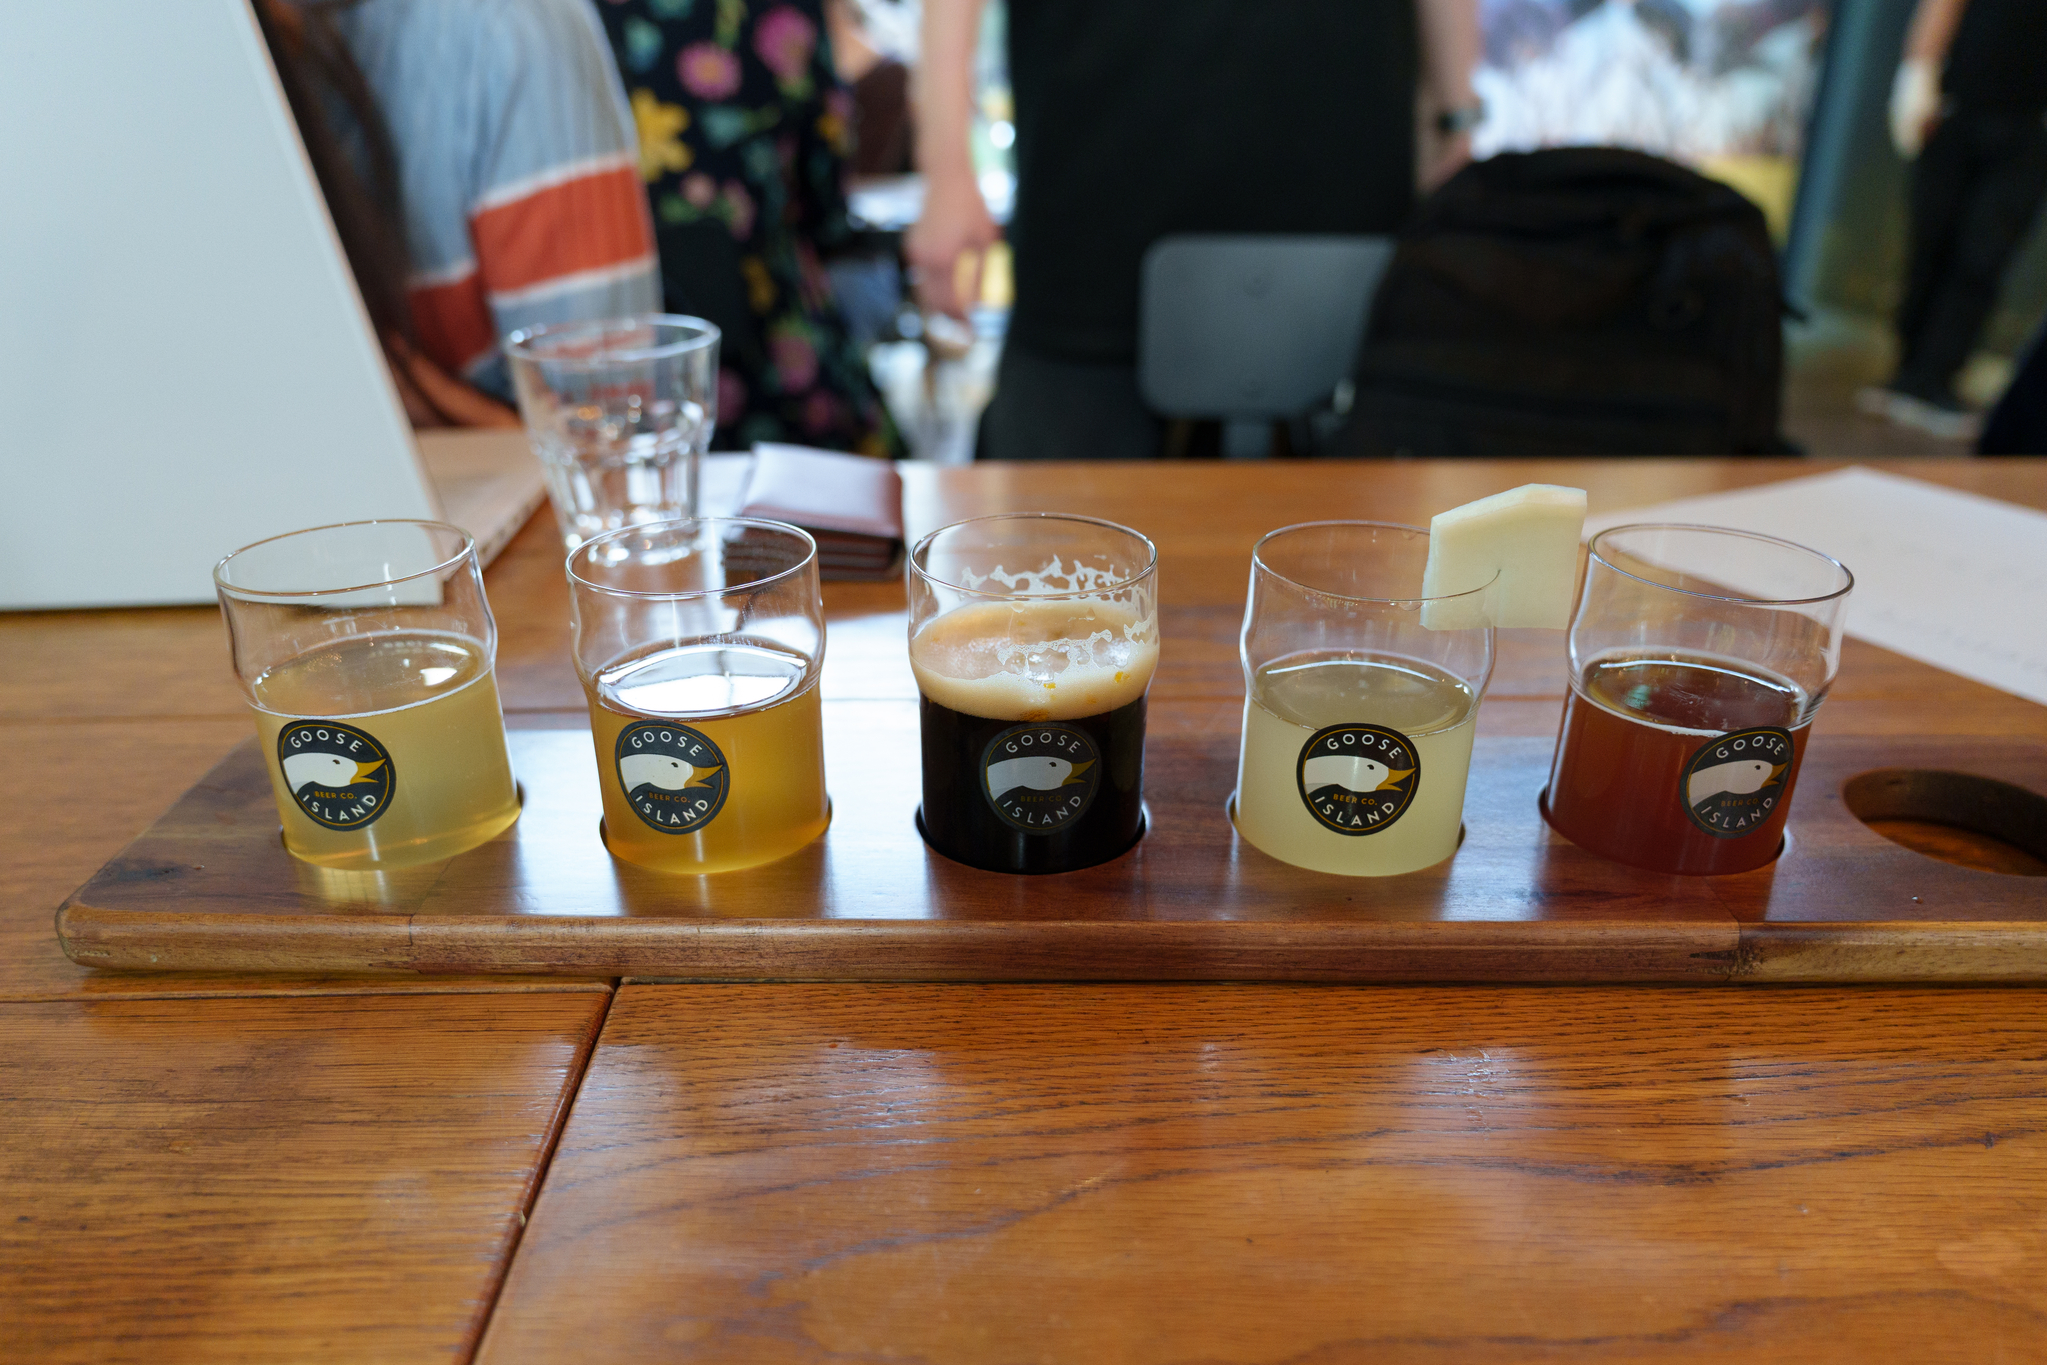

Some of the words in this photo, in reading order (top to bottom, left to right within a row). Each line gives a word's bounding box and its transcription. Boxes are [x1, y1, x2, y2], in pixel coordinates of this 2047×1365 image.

[290, 729, 363, 753] GOOSE
[631, 731, 703, 757] GOOSE
[1005, 732, 1081, 753] GOOSE
[1326, 733, 1402, 759] GOOSE
[1715, 735, 1784, 759] GOOSE
[314, 790, 337, 799] BEER
[340, 792, 358, 800] CO.
[648, 792, 671, 801] BEER
[674, 796, 691, 804] CO.
[1020, 795, 1045, 803] BEER
[1333, 793, 1358, 804] BEER
[1361, 797, 1378, 806] CO.
[303, 794, 377, 821] ISLAND
[635, 799, 709, 824] ISLAND
[1002, 795, 1081, 825] ISLAND
[1314, 796, 1395, 826] ISLAND
[1700, 797, 1772, 828] ISLAND
